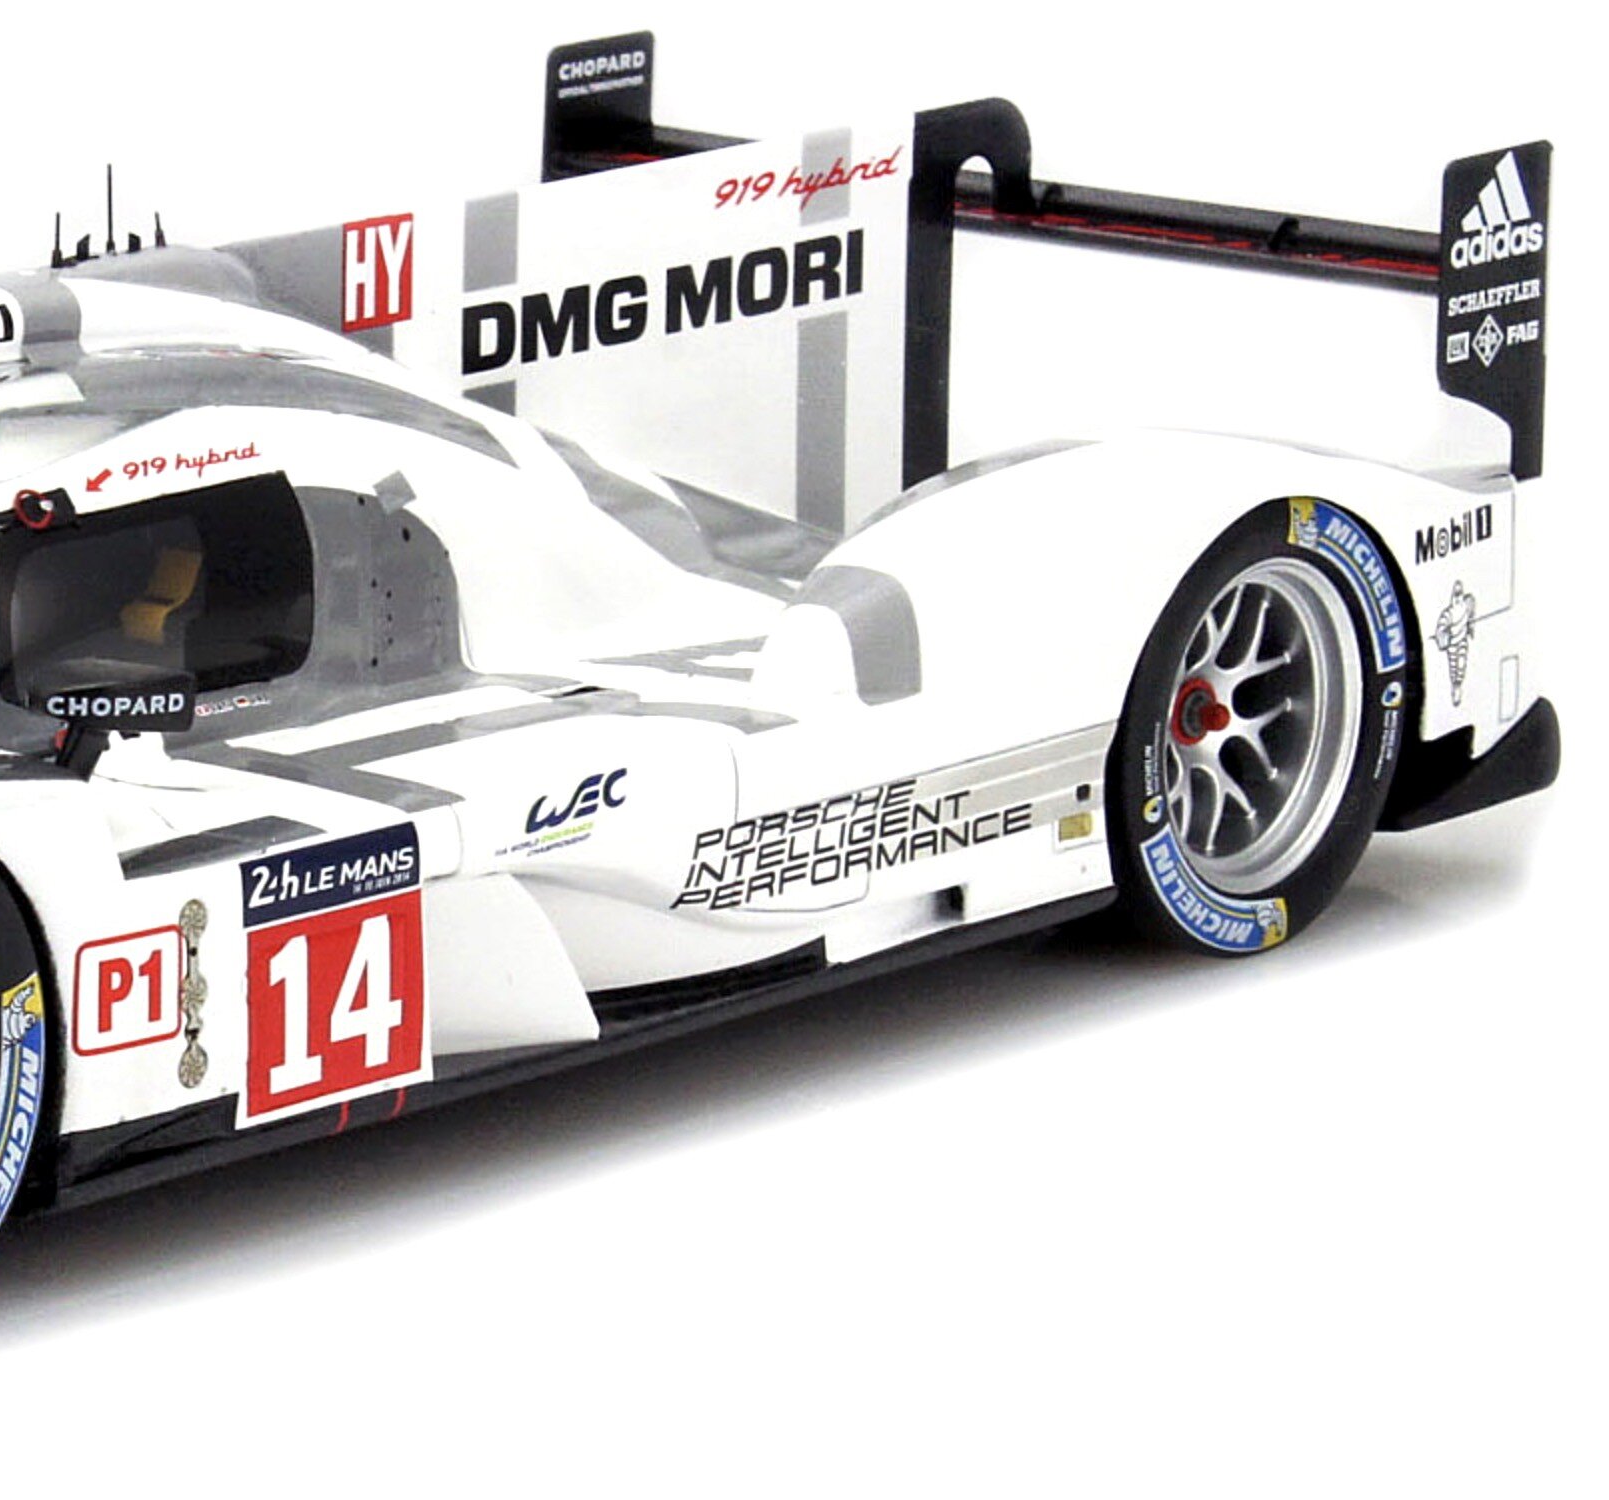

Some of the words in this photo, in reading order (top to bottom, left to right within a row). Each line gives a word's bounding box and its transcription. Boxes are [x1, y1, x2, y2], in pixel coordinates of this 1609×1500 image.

[558, 51, 646, 81] CHOPARD
[714, 172, 775, 209] 919
[778, 145, 904, 211] hybrid
[345, 222, 412, 324] HY
[1451, 222, 1544, 269] adidas
[462, 275, 648, 375] DMG
[665, 228, 864, 335] MORI
[1448, 279, 1541, 317] SCHAEFFLER
[1506, 320, 1540, 346] FAG
[122, 456, 167, 480] 919
[174, 441, 261, 479] hybrid
[1415, 517, 1474, 566] Mobil
[1324, 513, 1405, 660] MICHELIN
[47, 693, 184, 718] CHOPARD
[684, 790, 971, 889] INTELLIGENT
[692, 778, 917, 860] PORSCHE
[303, 865, 336, 895] LE
[339, 846, 414, 885] MANS
[669, 803, 1033, 911] PERFORMANCE
[1150, 845, 1257, 946] MICHELIN
[97, 949, 163, 1034] P1
[269, 913, 403, 1096] 14
